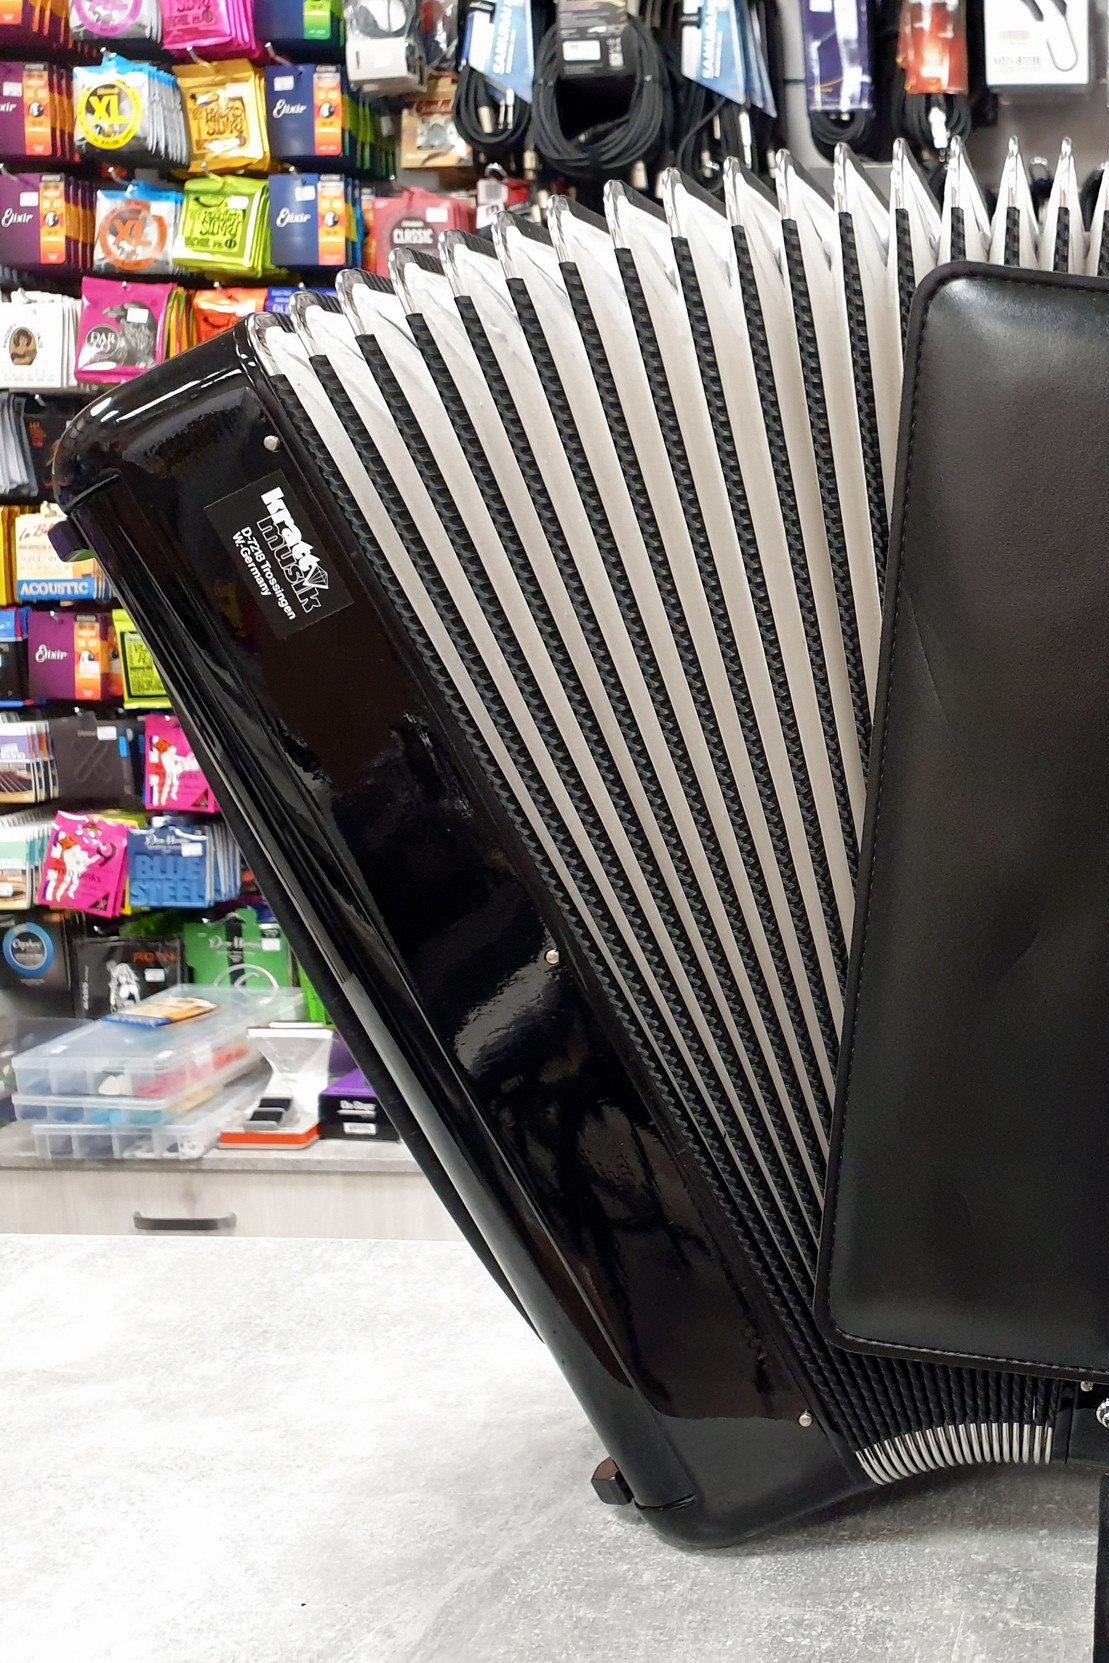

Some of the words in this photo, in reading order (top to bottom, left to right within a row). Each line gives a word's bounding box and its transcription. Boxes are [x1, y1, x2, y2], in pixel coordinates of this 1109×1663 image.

[88, 94, 128, 125] XL
[272, 98, 308, 119] Elixir
[1, 207, 33, 227] Elixir
[276, 207, 311, 227] Elixir
[113, 217, 152, 248] XL
[392, 227, 434, 244] CLASSIC
[232, 530, 272, 597] W.-Germany
[241, 526, 267, 562] D-7218
[260, 559, 297, 620] Trossingen
[20, 581, 89, 596] ACOUSTIC
[35, 644, 68, 663] Elixir
[136, 853, 201, 876] BLUE
